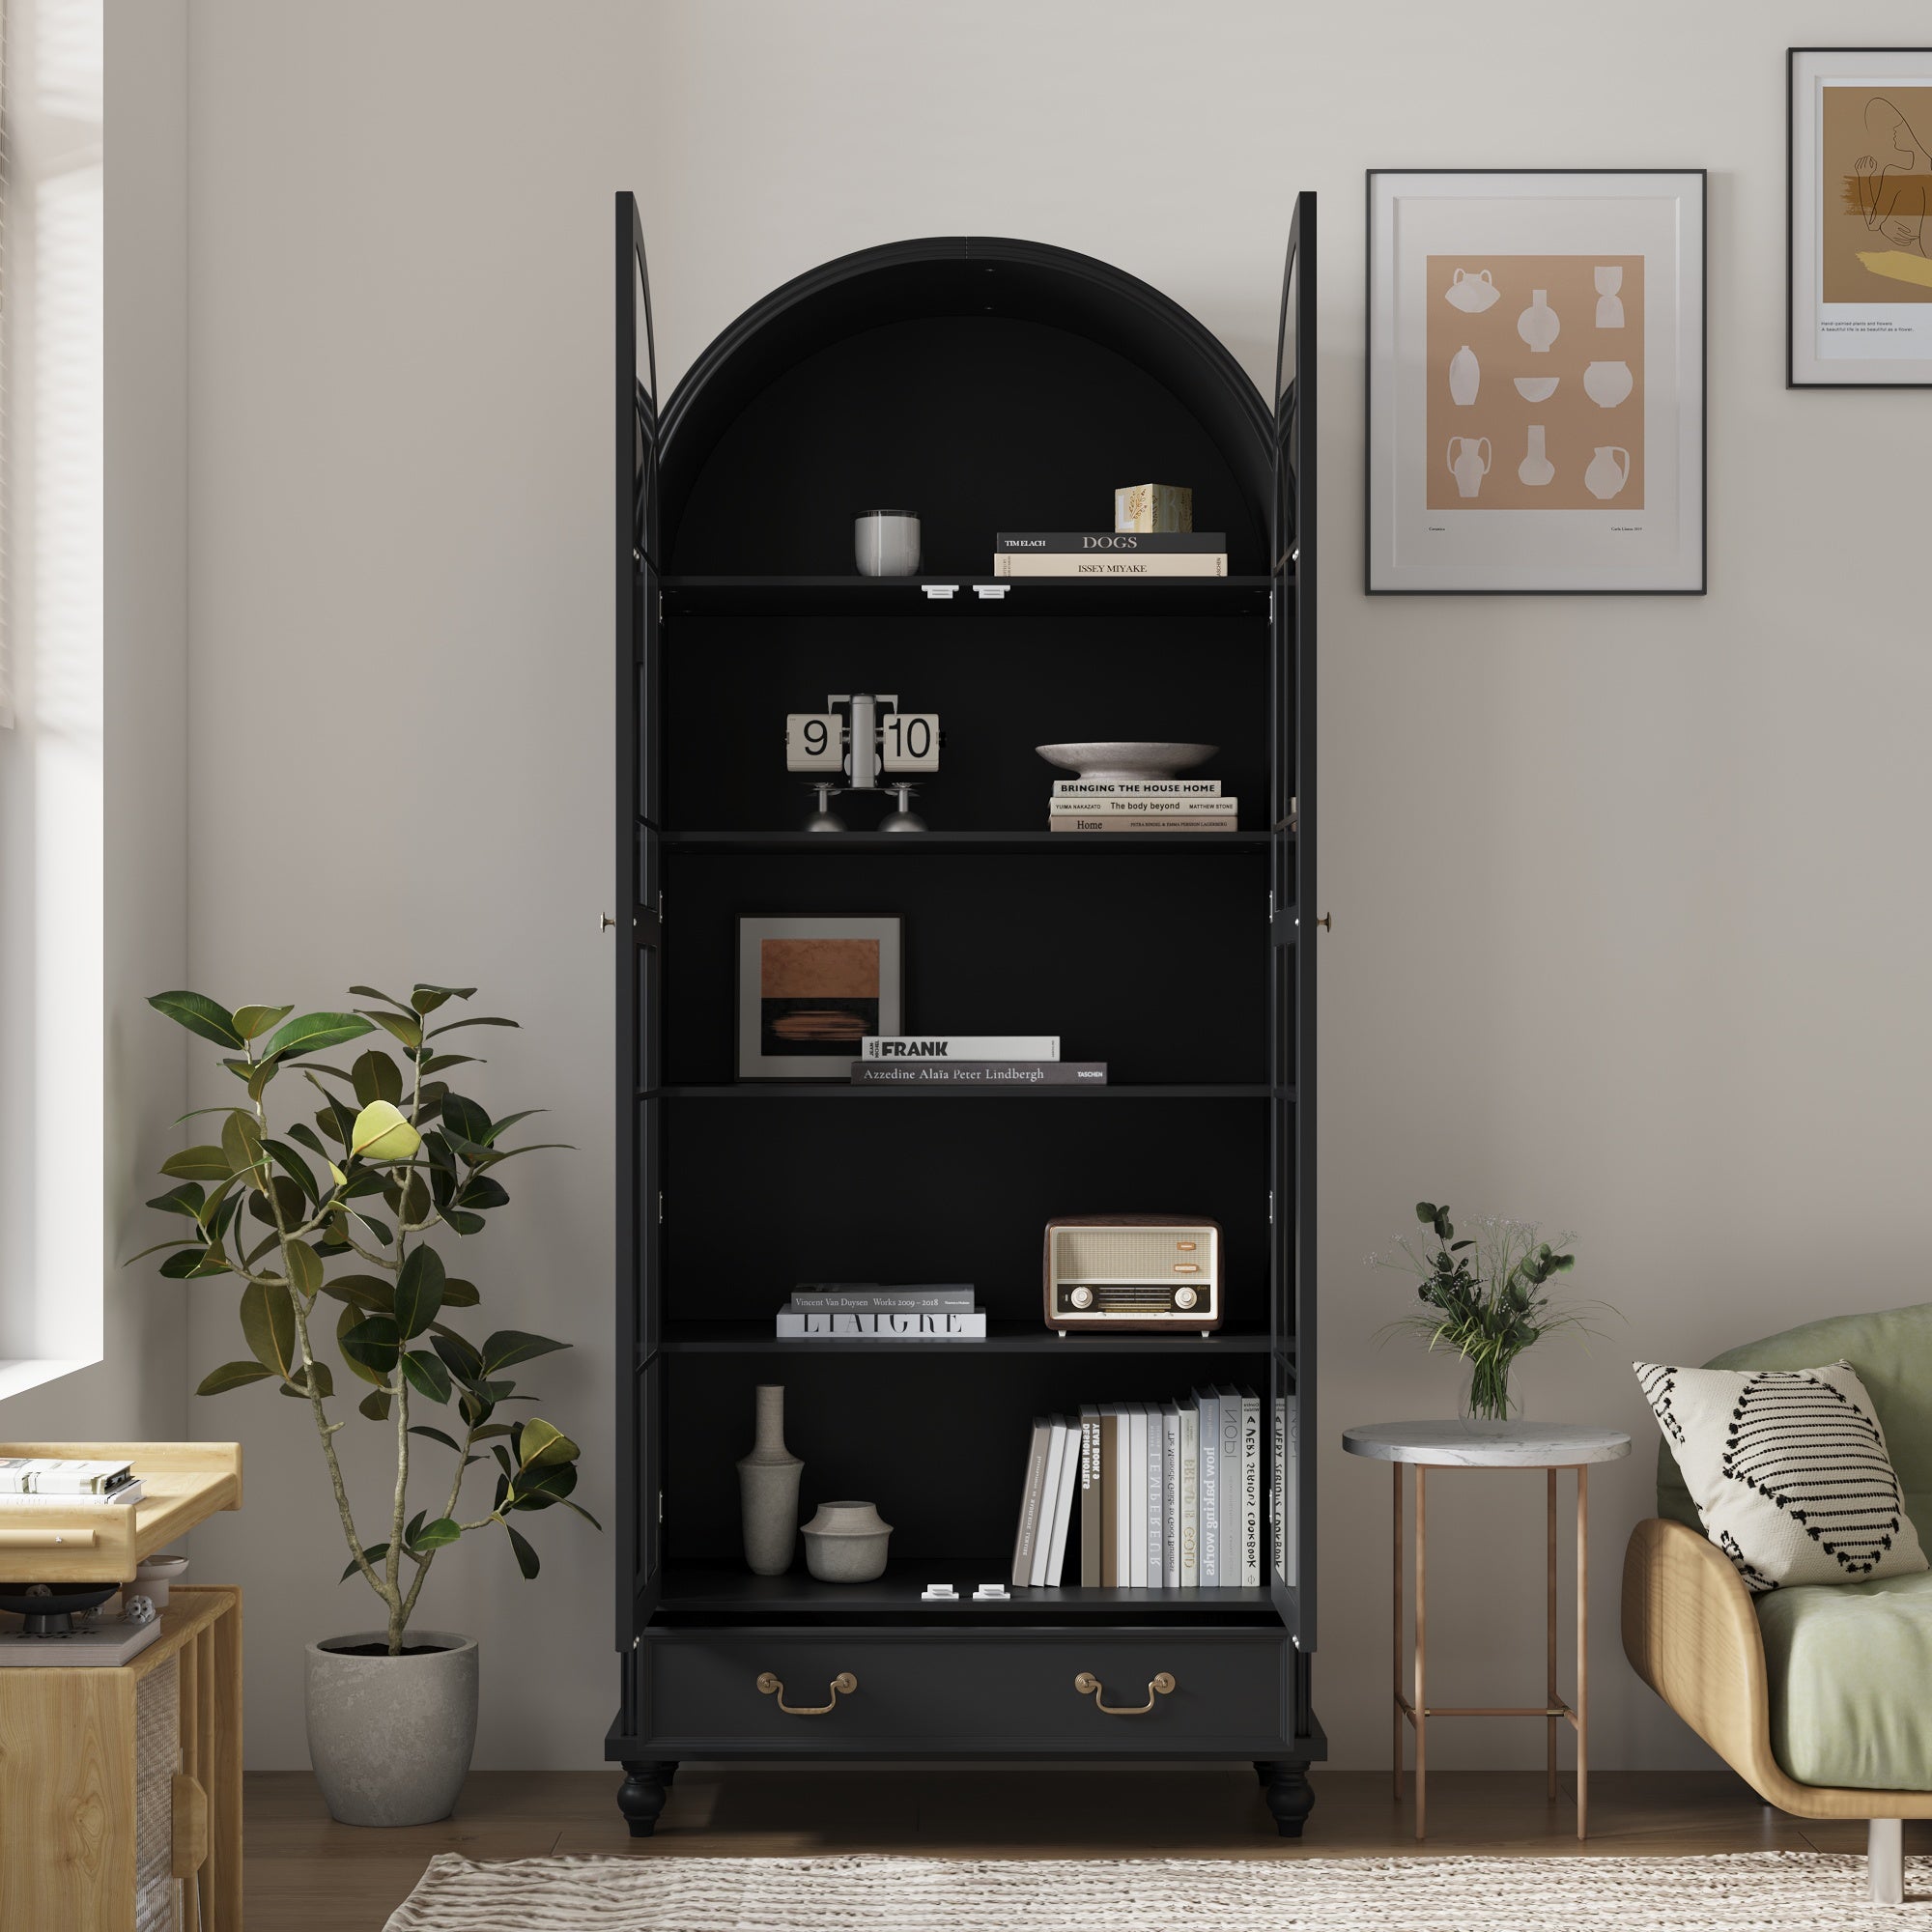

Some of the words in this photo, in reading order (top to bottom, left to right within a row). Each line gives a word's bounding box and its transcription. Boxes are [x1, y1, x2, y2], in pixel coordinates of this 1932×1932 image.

[1082, 536, 1138, 550] DOGS
[1078, 564, 1105, 573] ISSEY
[1106, 564, 1148, 573] MIYAKE
[804, 720, 828, 755] 9
[889, 718, 931, 758] 10
[1127, 802, 1148, 811] body
[1150, 802, 1180, 811] beyond
[1076, 820, 1103, 830] Home
[881, 1041, 949, 1057] FRANK
[864, 1067, 916, 1079] Azzedine
[919, 1067, 950, 1079] Alaïa
[952, 1068, 981, 1079] Peter
[985, 1067, 1044, 1082] Lindbergh
[795, 1297, 824, 1306] Vincent
[825, 1297, 839, 1306] Van
[840, 1297, 868, 1308] Duysen
[872, 1297, 896, 1306] Works
